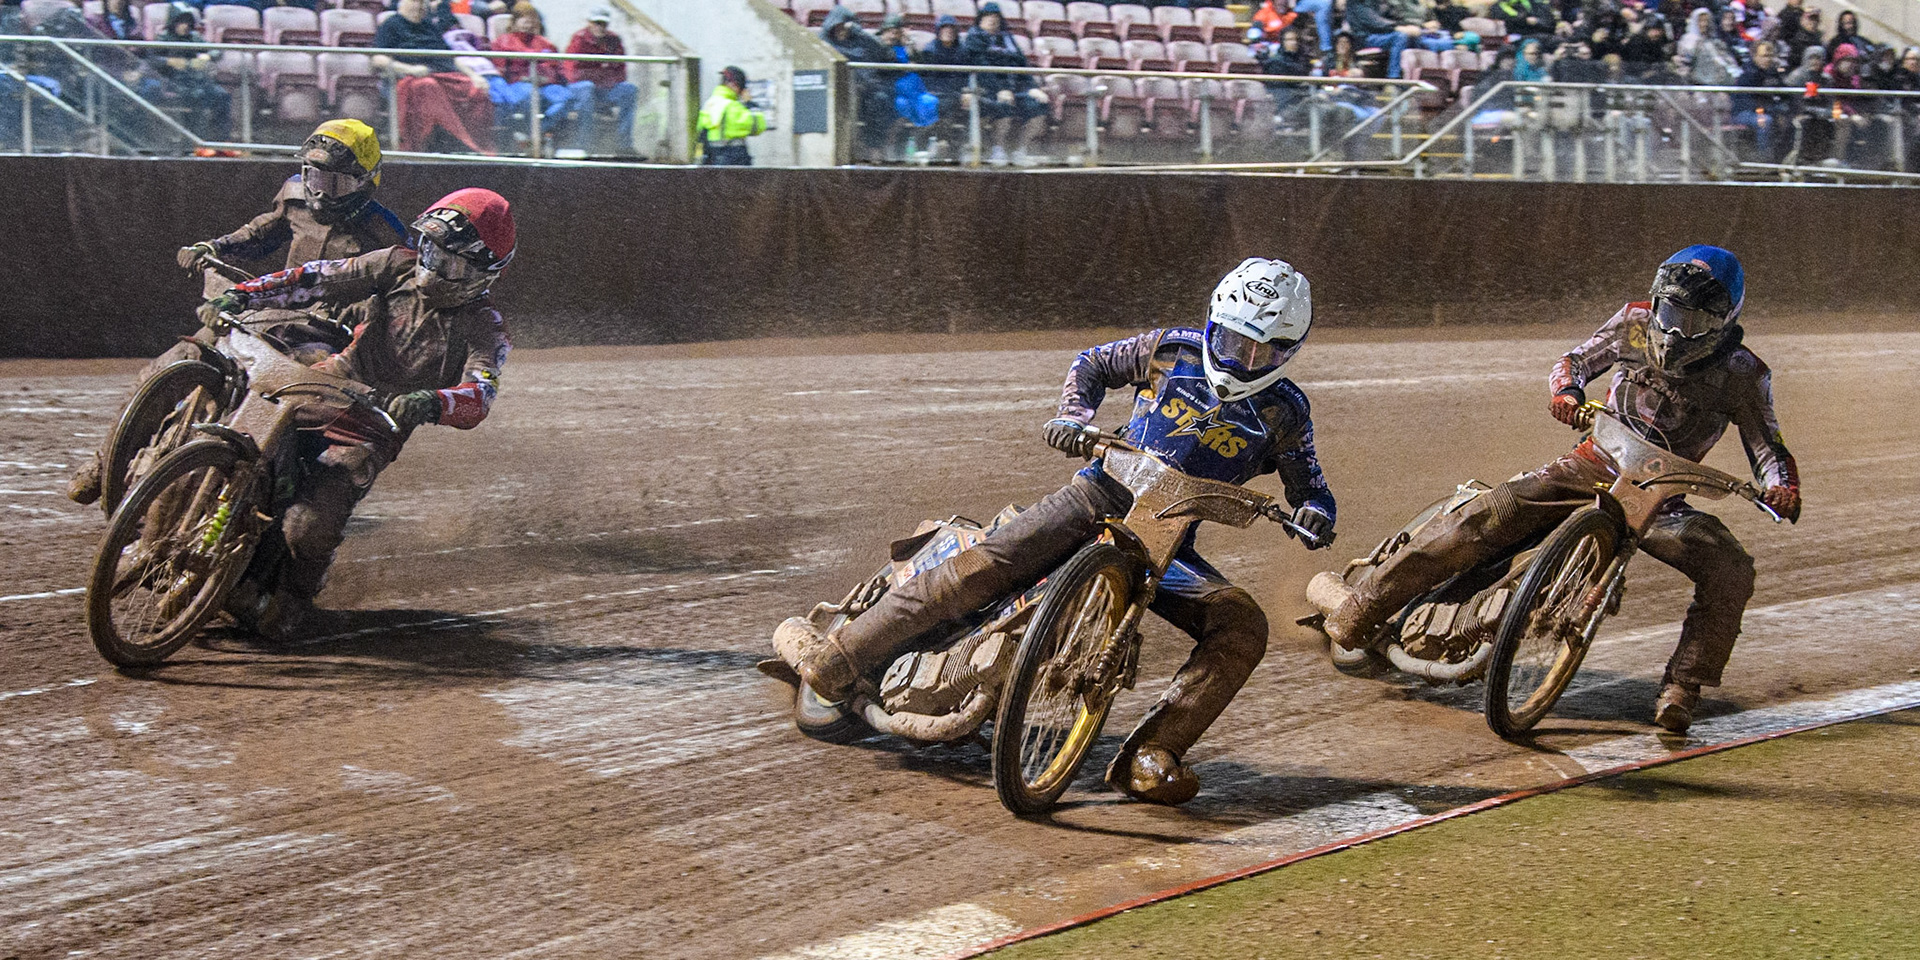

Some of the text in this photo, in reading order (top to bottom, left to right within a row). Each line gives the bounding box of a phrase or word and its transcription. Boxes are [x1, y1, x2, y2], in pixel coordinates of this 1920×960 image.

[1248, 282, 1276, 297] Arai
[1194, 399, 1210, 411] LYNN
[1161, 398, 1248, 458] STARS
